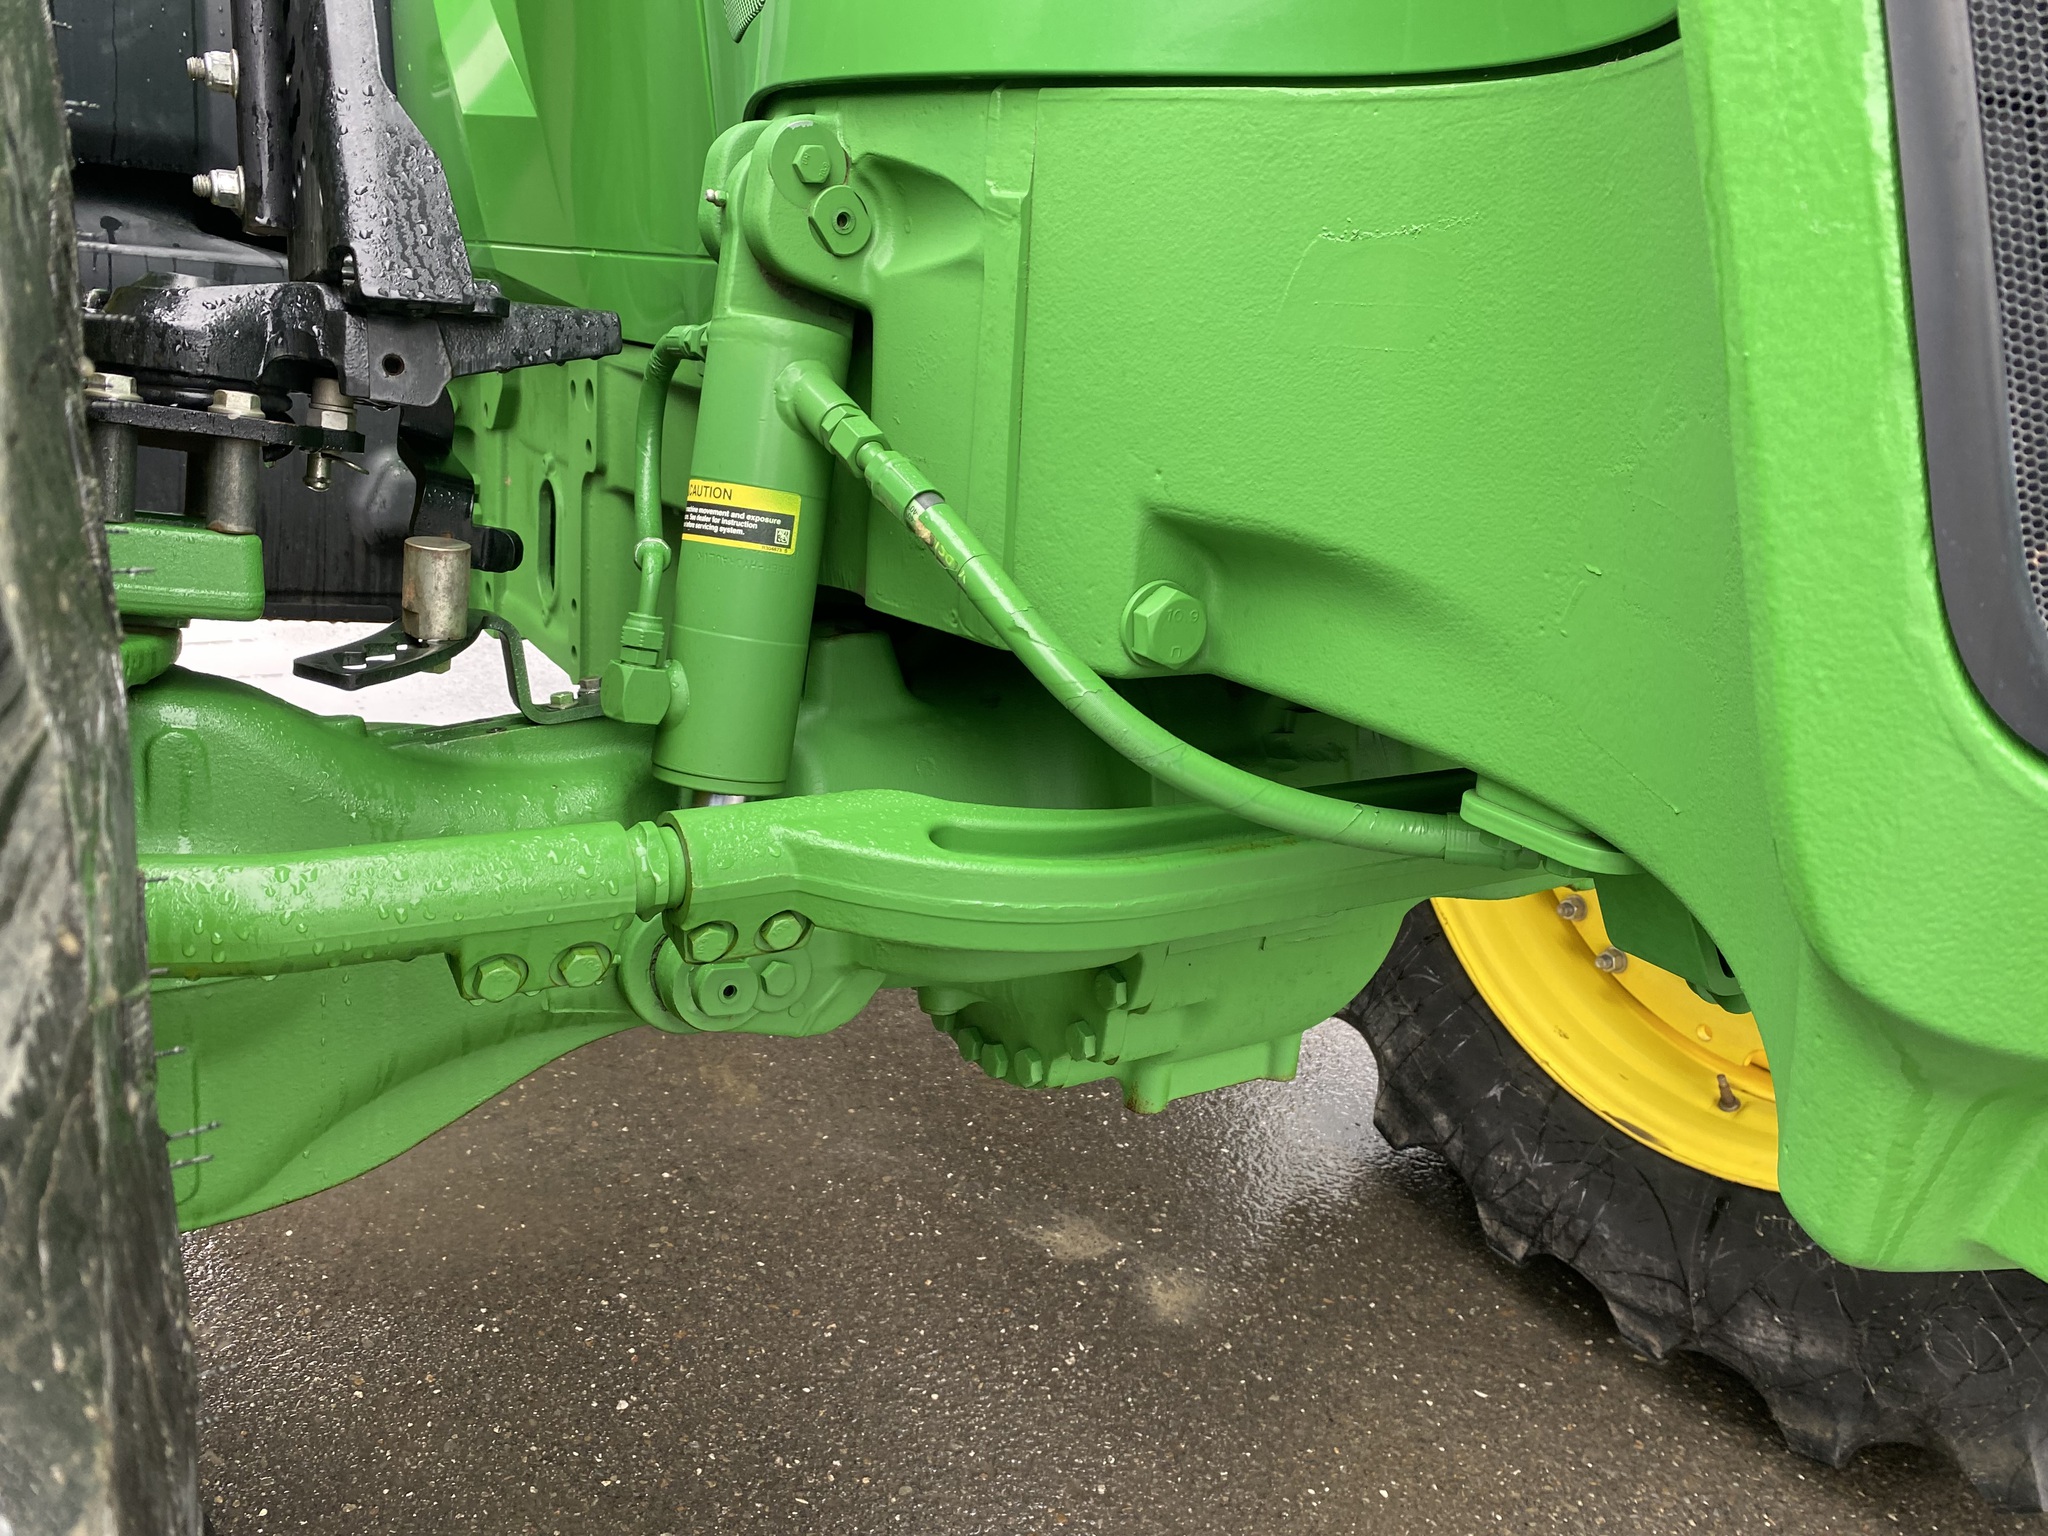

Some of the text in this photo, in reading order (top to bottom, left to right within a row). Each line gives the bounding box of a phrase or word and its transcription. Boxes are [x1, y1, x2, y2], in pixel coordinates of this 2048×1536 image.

[689, 484, 733, 501] CAUTION
[698, 507, 730, 517] movement
[730, 510, 746, 519] and
[746, 514, 782, 525] exposure
[721, 518, 758, 529] instruction
[695, 522, 719, 533] servicing
[719, 525, 746, 535] system.
